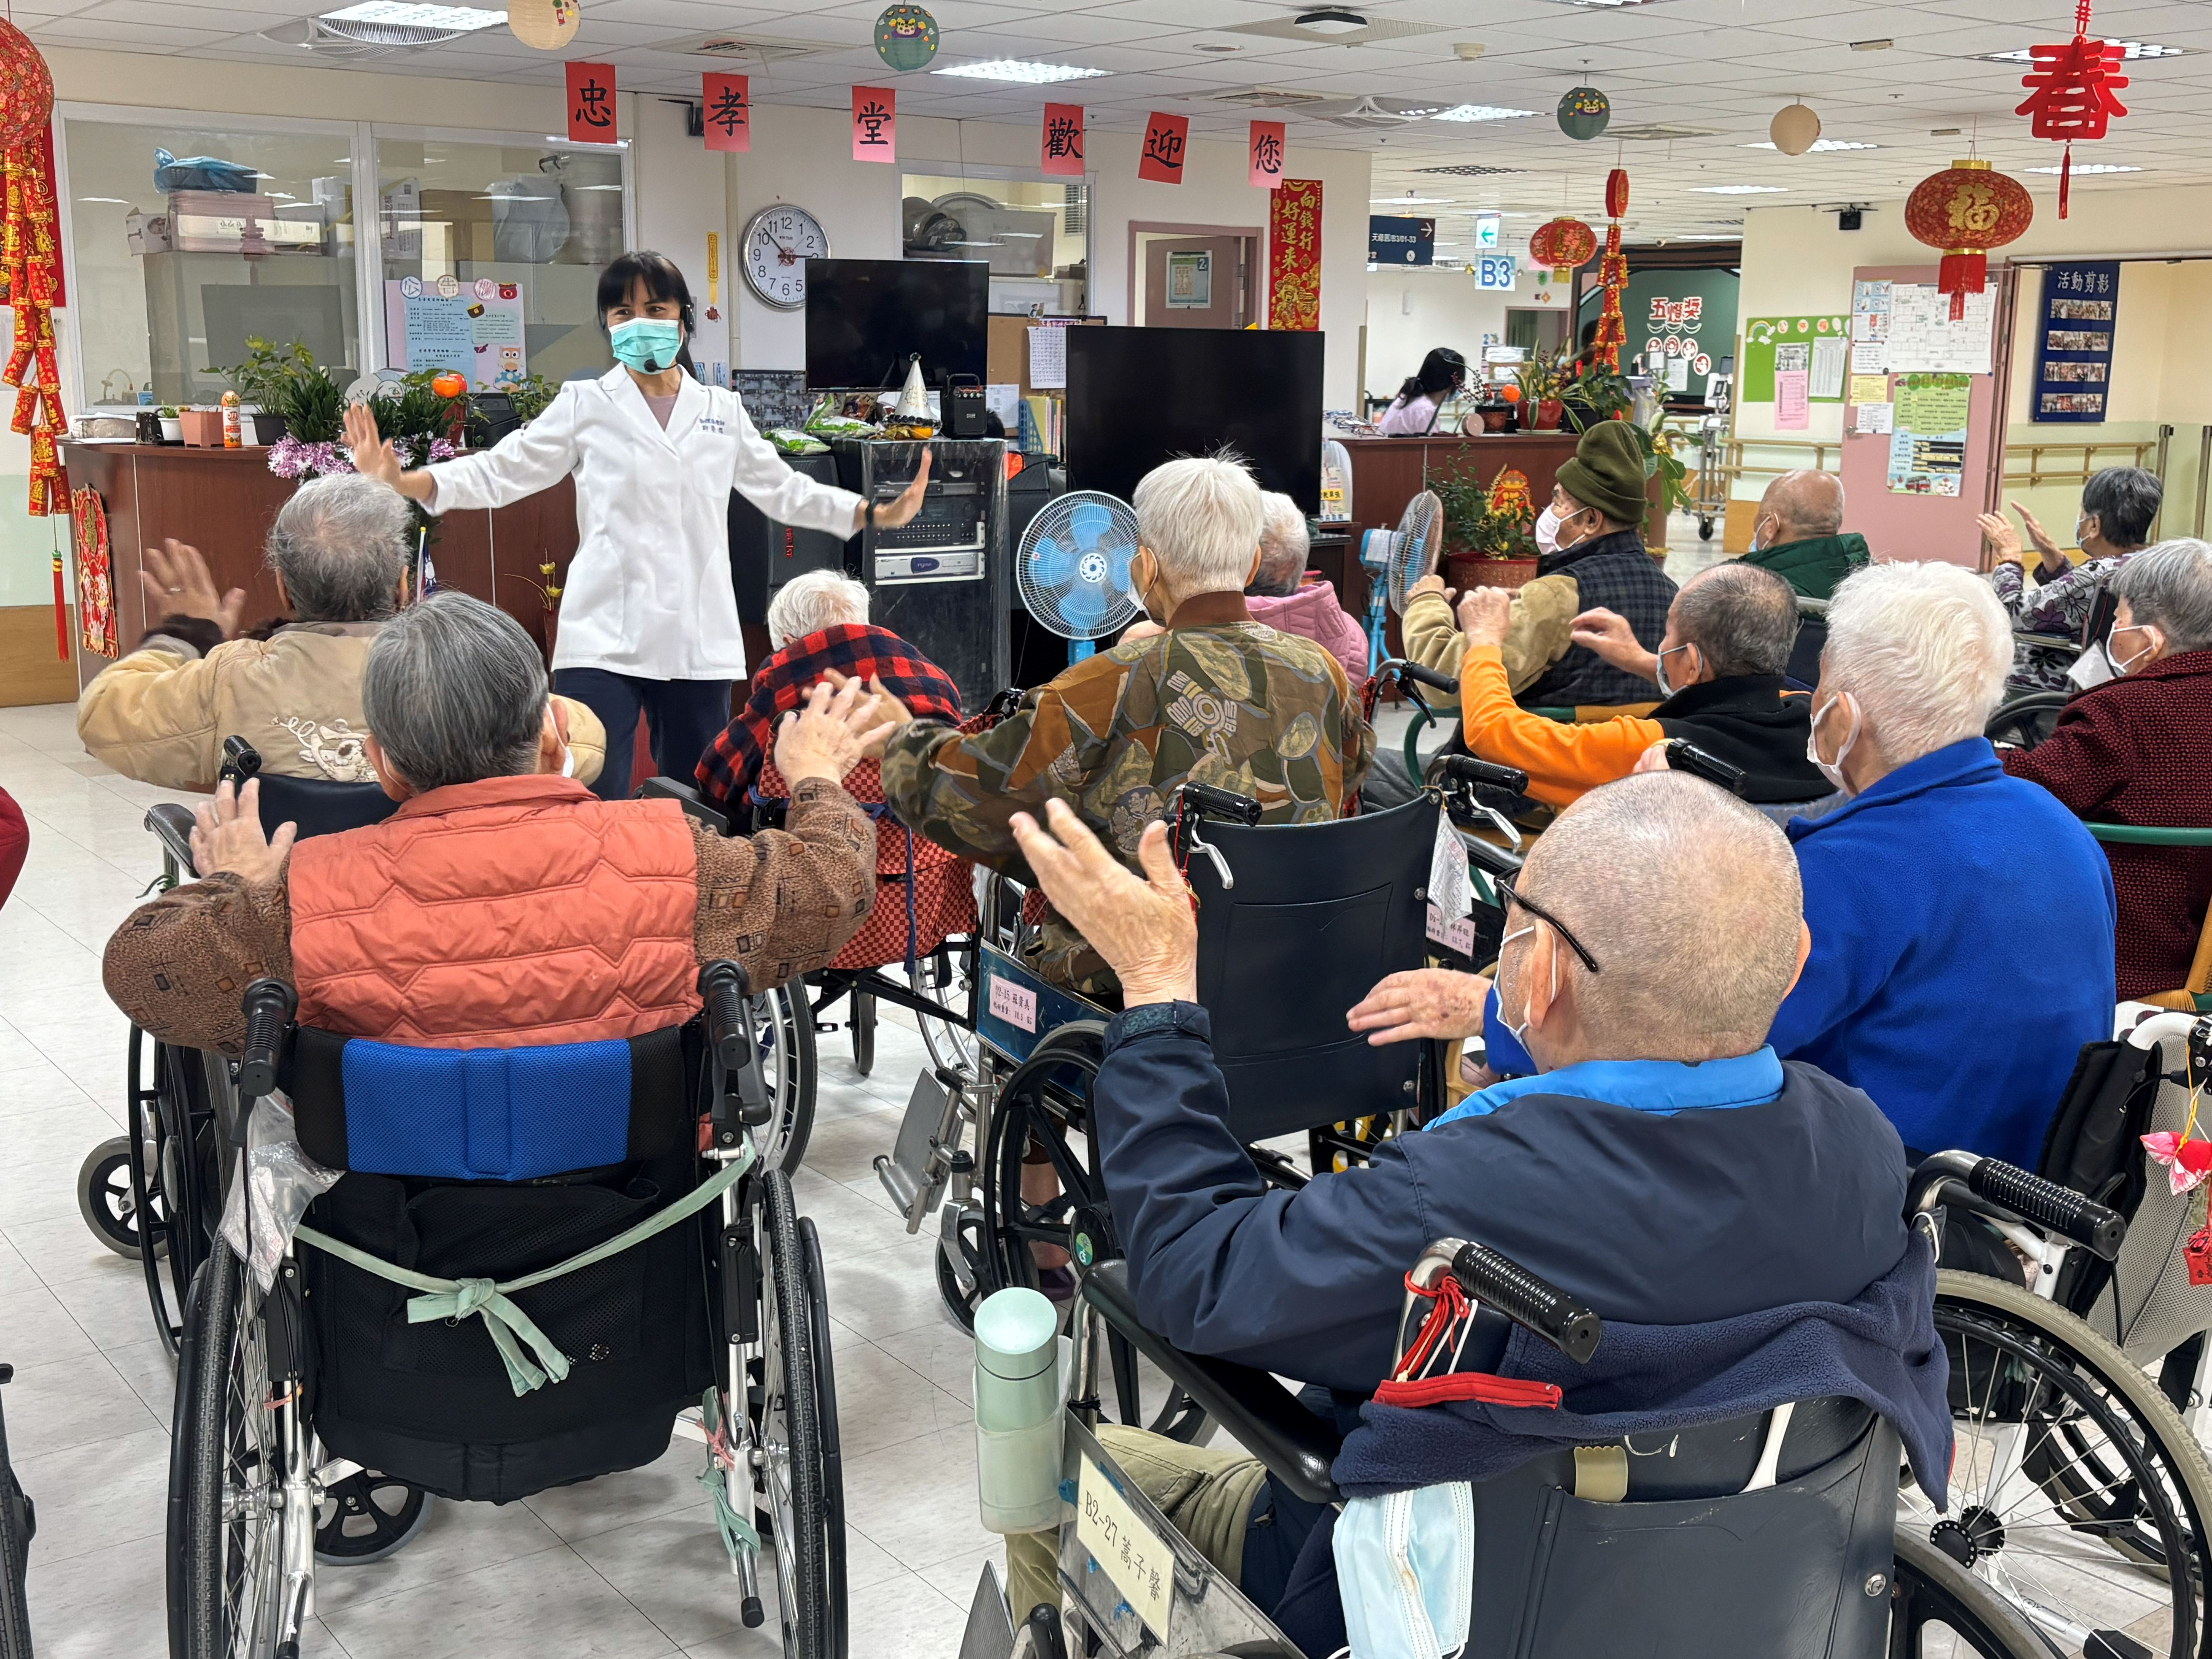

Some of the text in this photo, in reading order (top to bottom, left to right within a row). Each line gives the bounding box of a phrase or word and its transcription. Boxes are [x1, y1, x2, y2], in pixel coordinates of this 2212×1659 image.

[2015, 36, 2129, 140] 春
[575, 79, 1281, 174] 忠 孝 堂 歡 迎 您
[1944, 182, 2001, 231] 福
[781, 217, 792, 230] 12
[1298, 190, 1316, 251] 向錢行
[769, 221, 777, 234] 11
[799, 223, 803, 235] 1
[757, 232, 770, 245] 10
[807, 236, 814, 248] 2
[753, 249, 761, 261] 9
[1199, 258, 1205, 270] 2
[758, 265, 766, 278] 8
[1481, 259, 1510, 287] B3
[769, 278, 776, 290] 7
[795, 280, 803, 292] 5
[2057, 271, 2110, 294] 活動剪影
[782, 283, 790, 296] 6
[1085, 1490, 1117, 1547] B2-27
